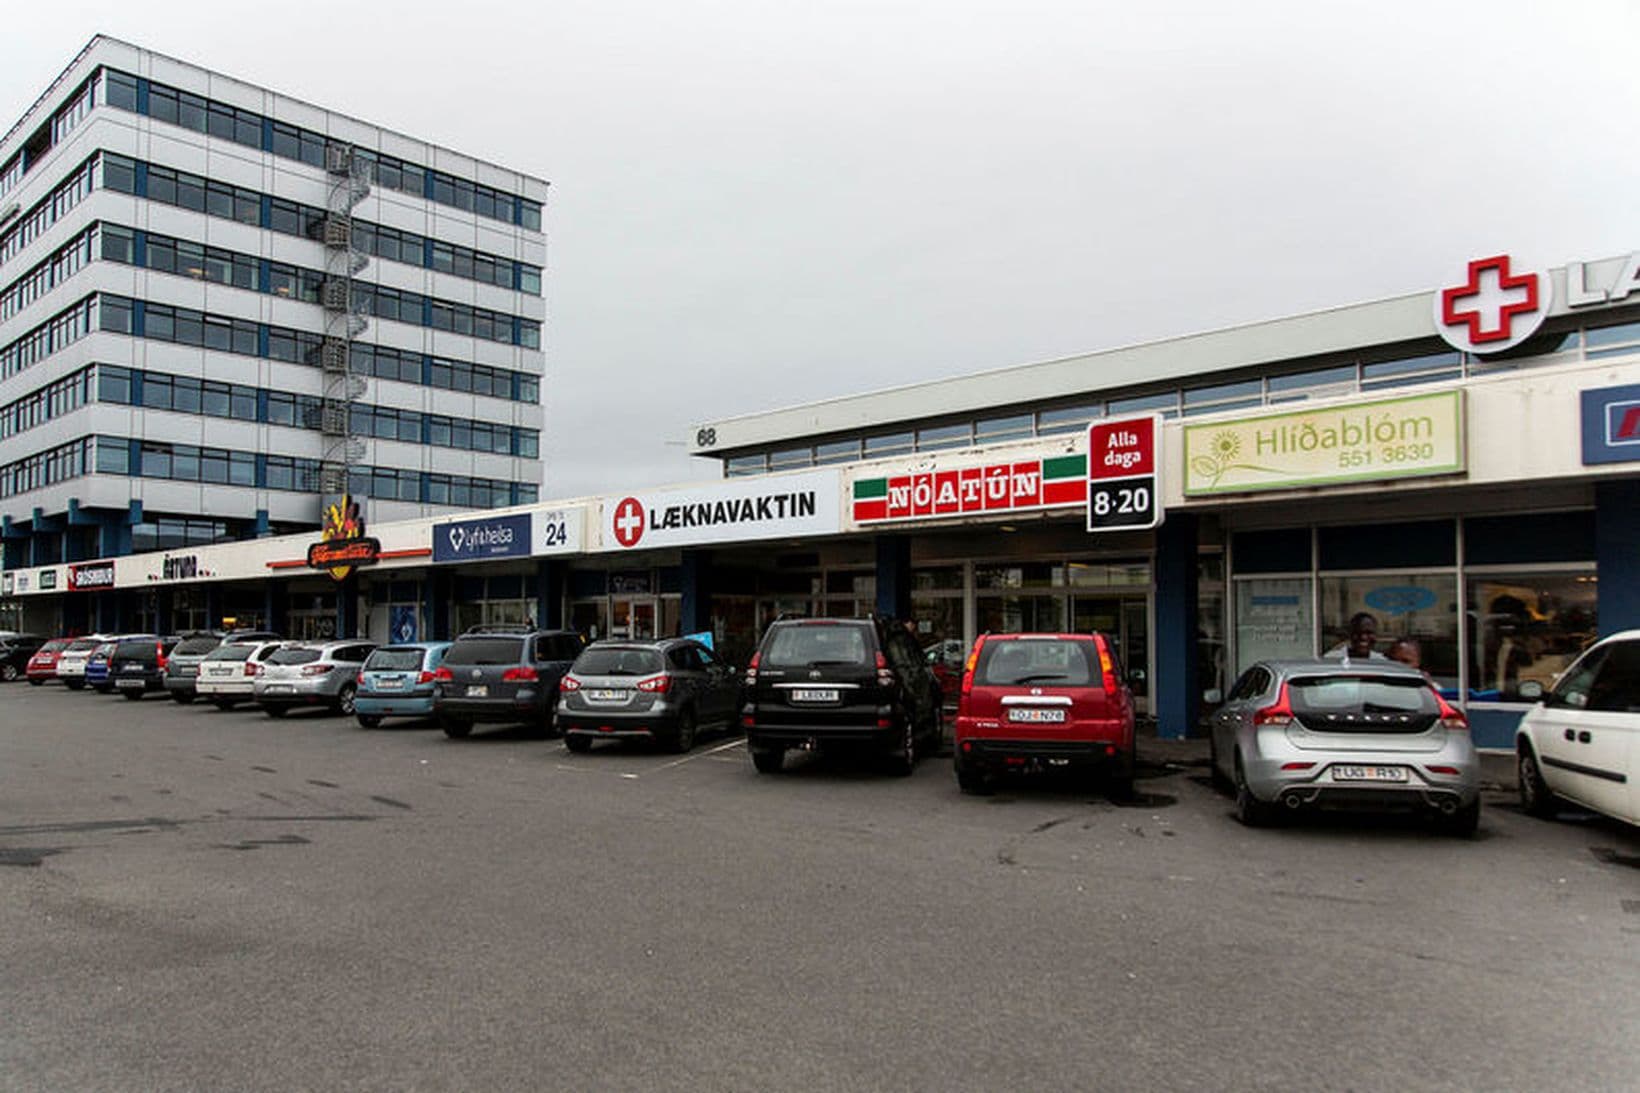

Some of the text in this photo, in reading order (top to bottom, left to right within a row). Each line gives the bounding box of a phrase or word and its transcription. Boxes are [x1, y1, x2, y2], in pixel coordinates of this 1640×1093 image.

[1107, 431, 1138, 449] Alla
[1256, 413, 1432, 456] Hlíðablóm
[1104, 449, 1141, 468] daga
[888, 467, 1039, 509] NÓATÚN
[650, 491, 815, 531] LÆKNAVAKTIN
[546, 522, 567, 546] 24
